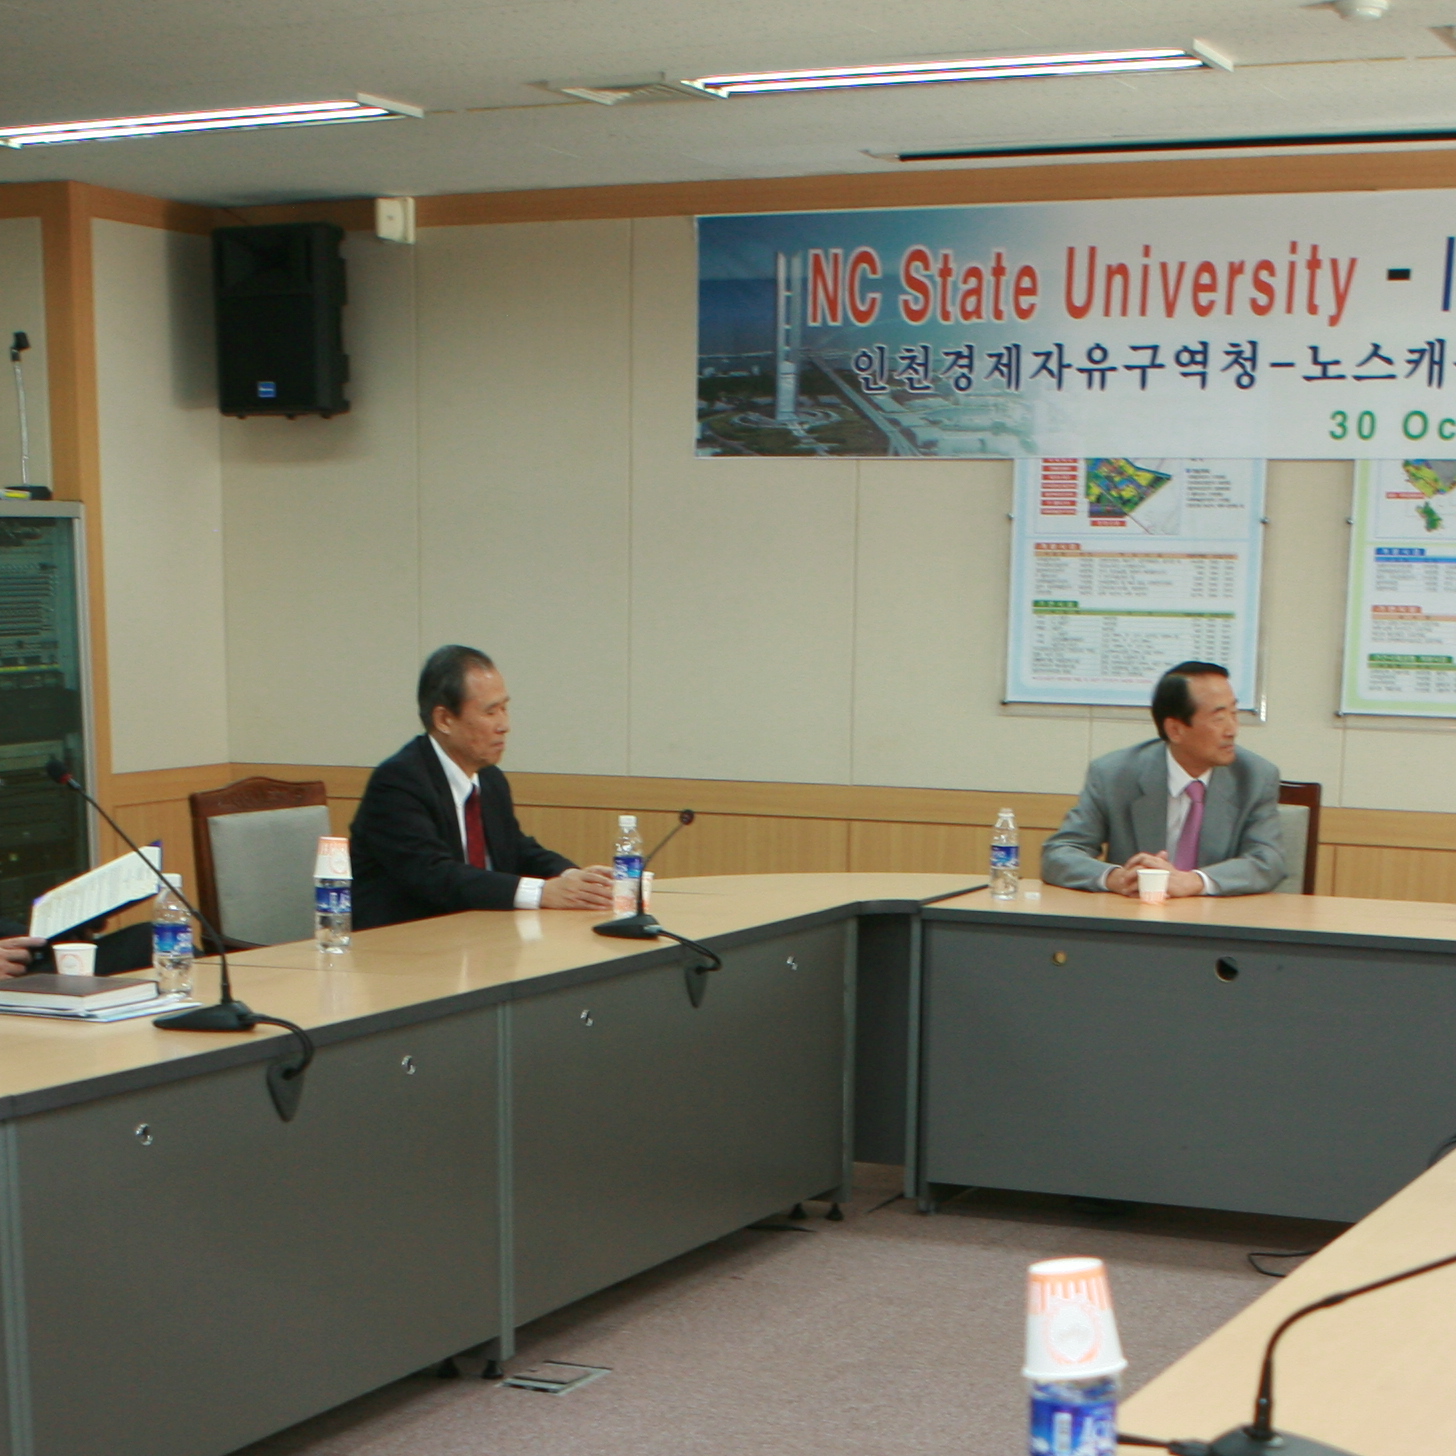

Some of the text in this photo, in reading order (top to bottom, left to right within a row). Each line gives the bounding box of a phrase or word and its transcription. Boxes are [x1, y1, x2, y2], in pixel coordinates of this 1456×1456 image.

[808, 248, 881, 326] NC
[899, 246, 1040, 325] State
[1065, 240, 1358, 327] University
[1387, 268, 1411, 281] -
[1328, 409, 1377, 440] 30
